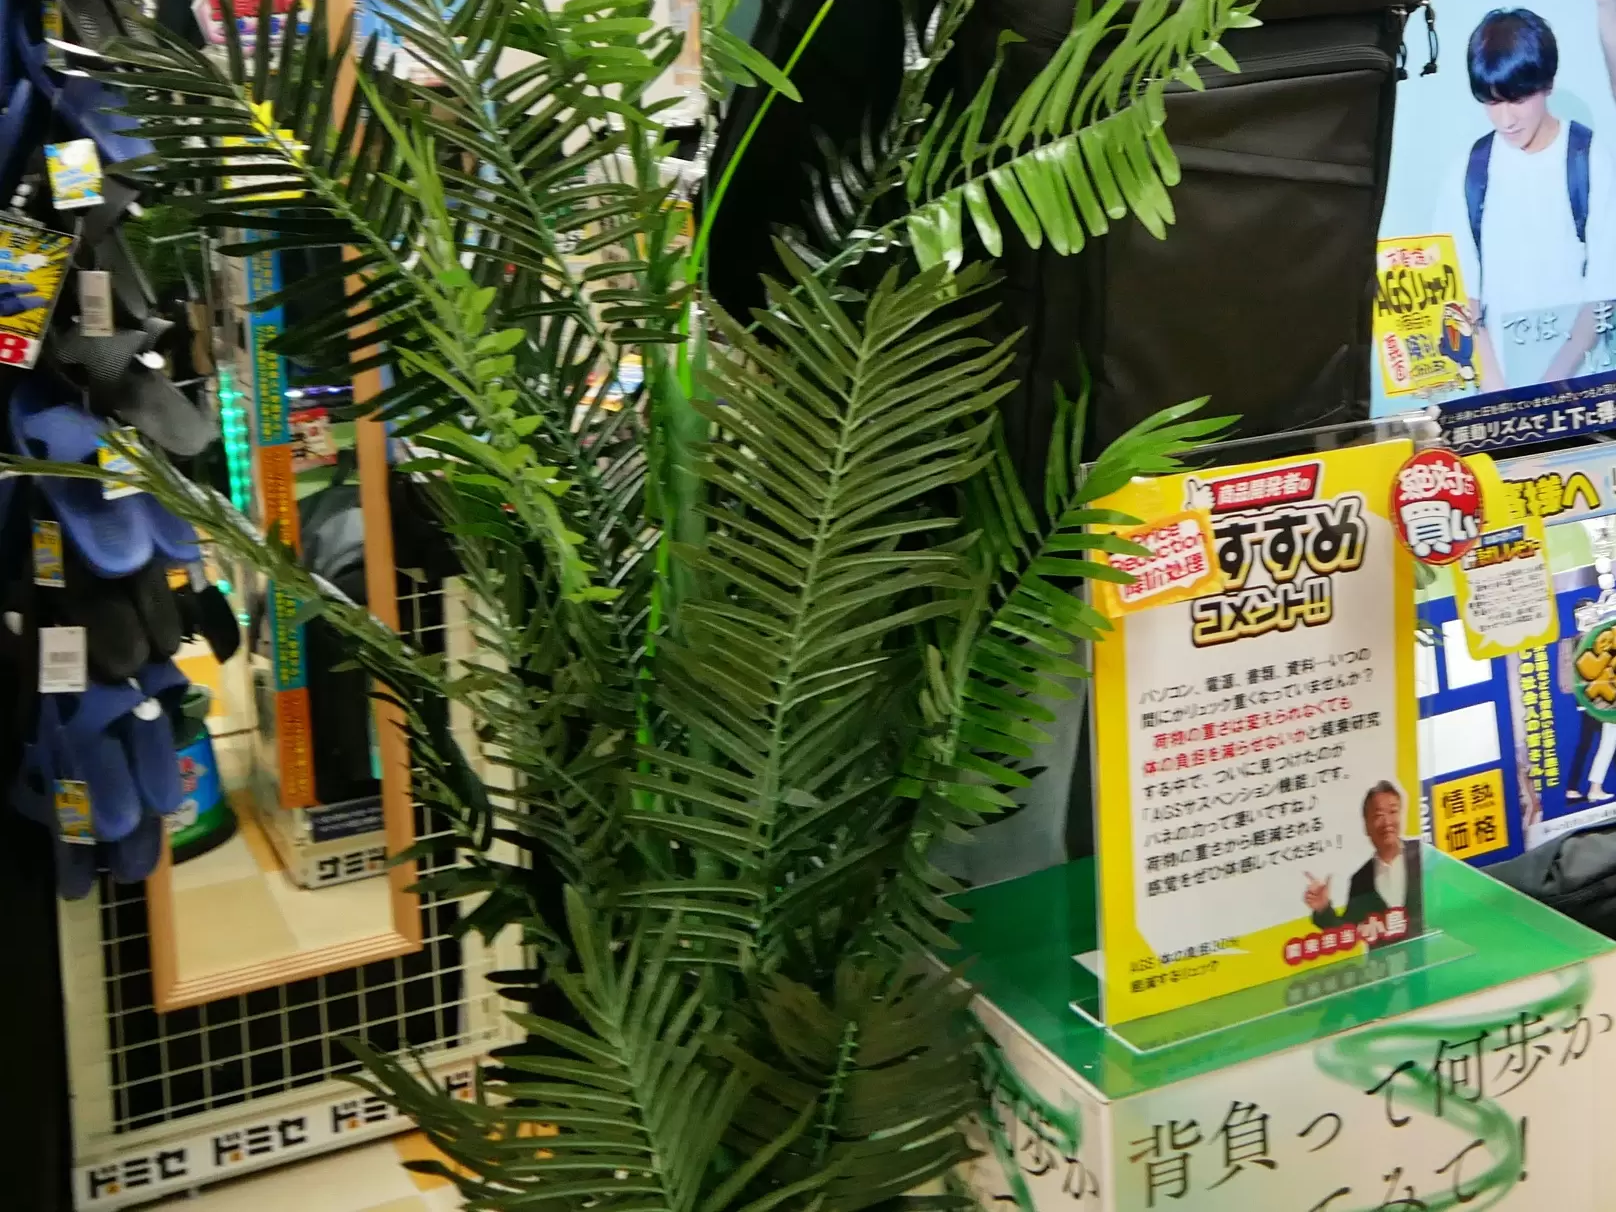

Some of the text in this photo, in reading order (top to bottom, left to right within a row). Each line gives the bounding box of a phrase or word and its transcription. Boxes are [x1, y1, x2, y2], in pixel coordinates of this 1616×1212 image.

[1502, 320, 1571, 345] では、
[1217, 472, 1310, 505] 商品開発者の
[1402, 501, 1480, 556] 買い
[1198, 578, 1330, 638] コメント!!
[87, 1148, 188, 1200] ドミセ
[212, 1116, 308, 1166] ドミセ
